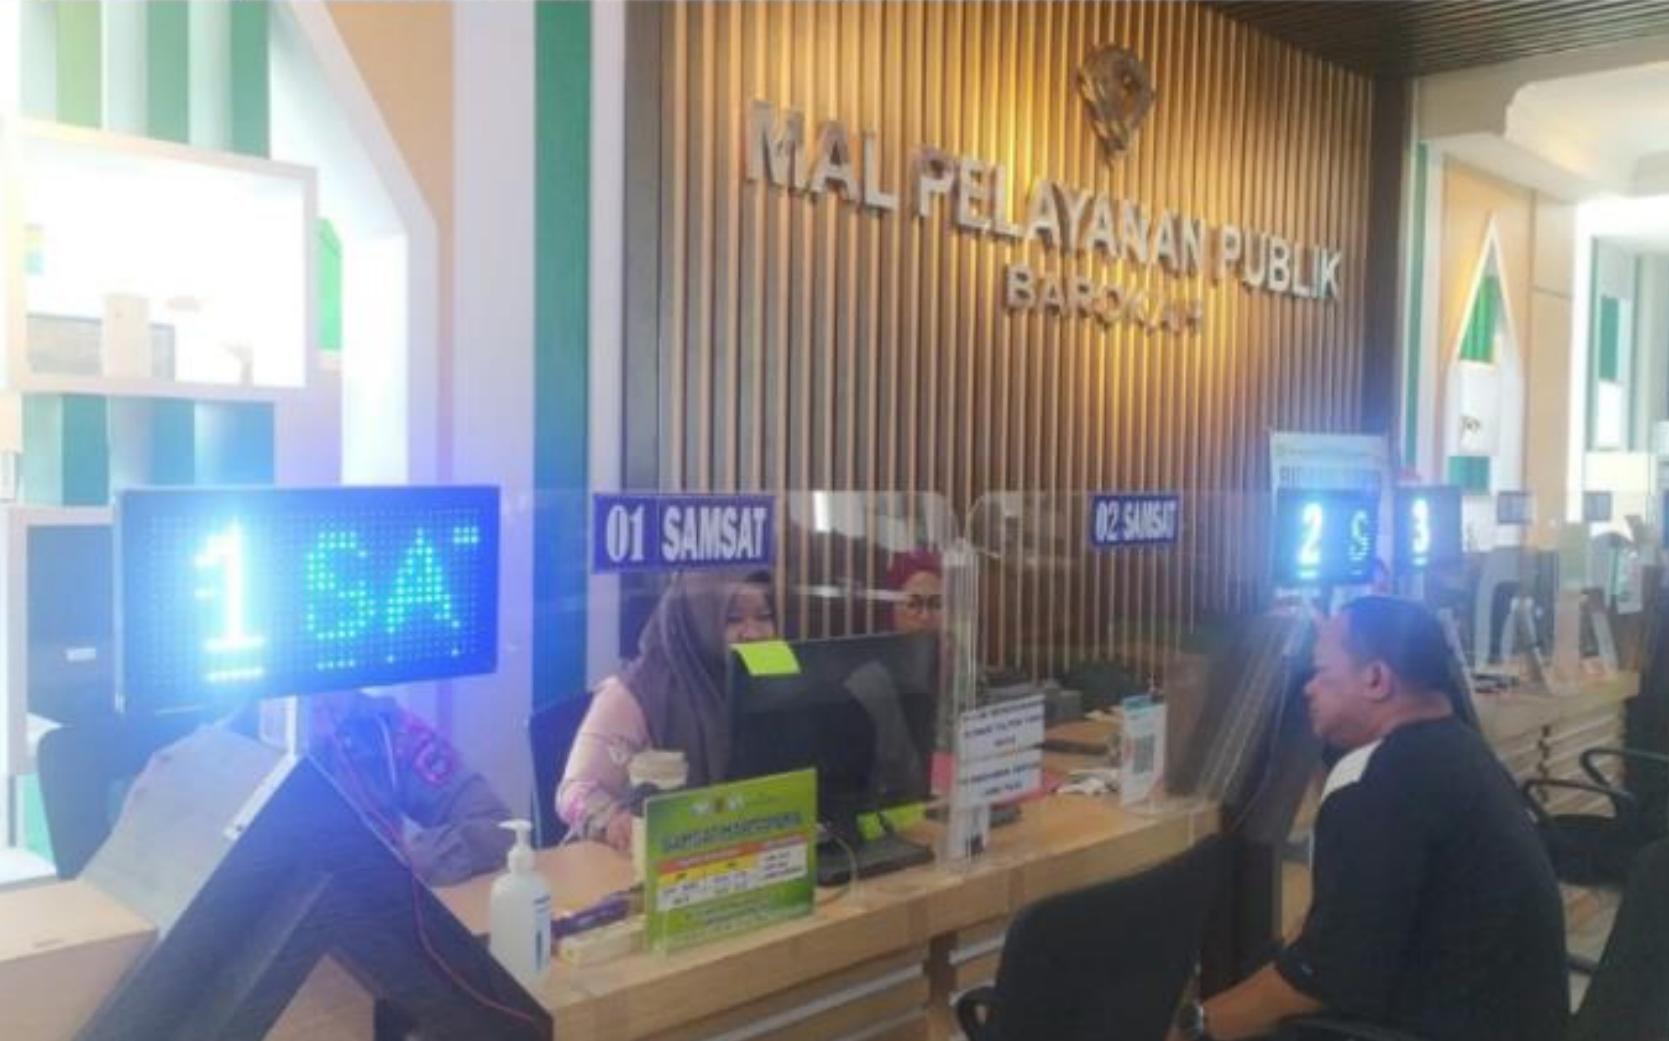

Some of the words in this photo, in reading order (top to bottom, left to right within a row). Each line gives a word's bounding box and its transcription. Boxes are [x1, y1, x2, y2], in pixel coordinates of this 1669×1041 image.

[746, 101, 899, 213] MAL
[916, 147, 1206, 272] PELAYANAN
[1219, 224, 1342, 300] PUBLIK
[606, 504, 645, 562] 01
[662, 505, 769, 562] SAMSAT
[1096, 500, 1119, 542] 02
[1299, 502, 1324, 566] 2
[1411, 497, 1431, 556] 3
[193, 516, 267, 652] 1
